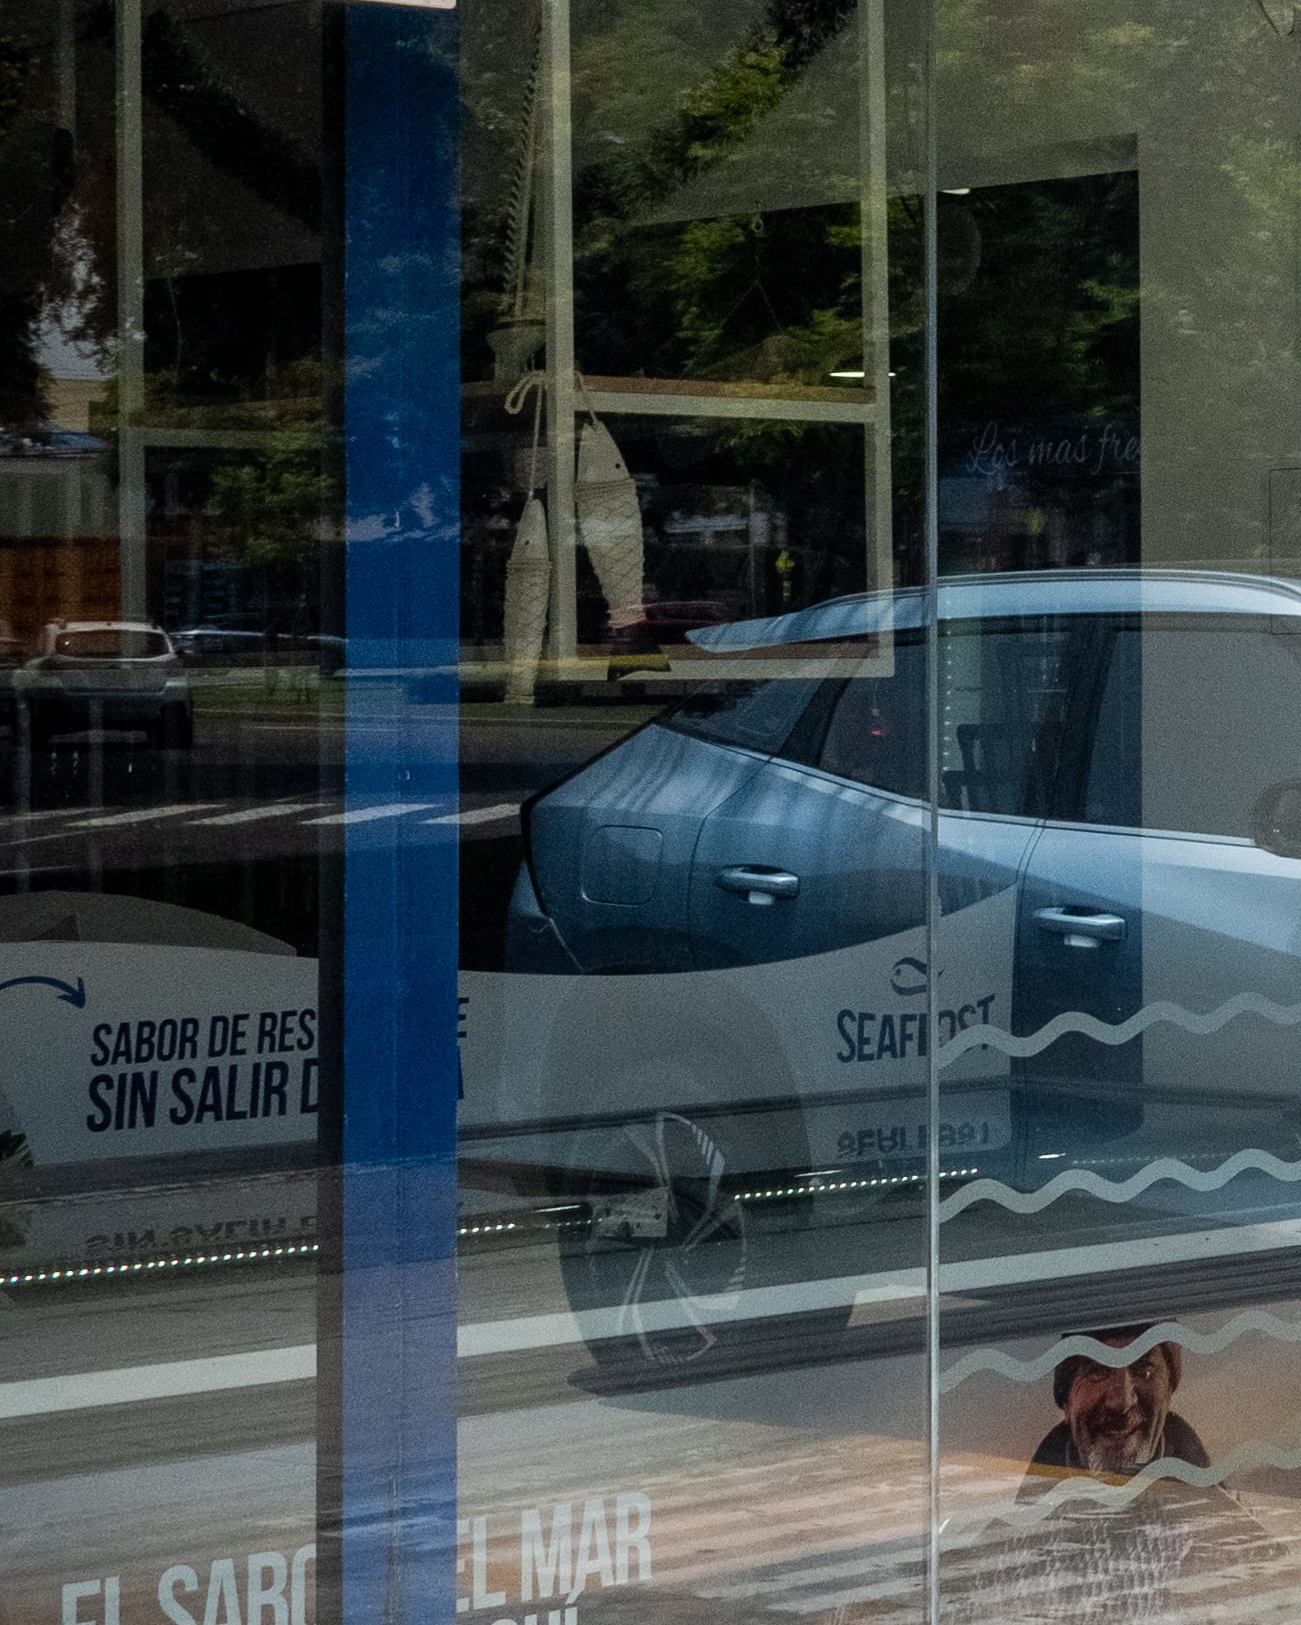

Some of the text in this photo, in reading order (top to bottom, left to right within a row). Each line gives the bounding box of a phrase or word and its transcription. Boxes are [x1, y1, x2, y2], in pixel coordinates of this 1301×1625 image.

[90, 1017, 199, 1066] SABOR
[207, 1014, 250, 1058] DE
[87, 1071, 158, 1133] SIN
[169, 1062, 288, 1125] SALIR
[521, 1492, 653, 1601] MAR
